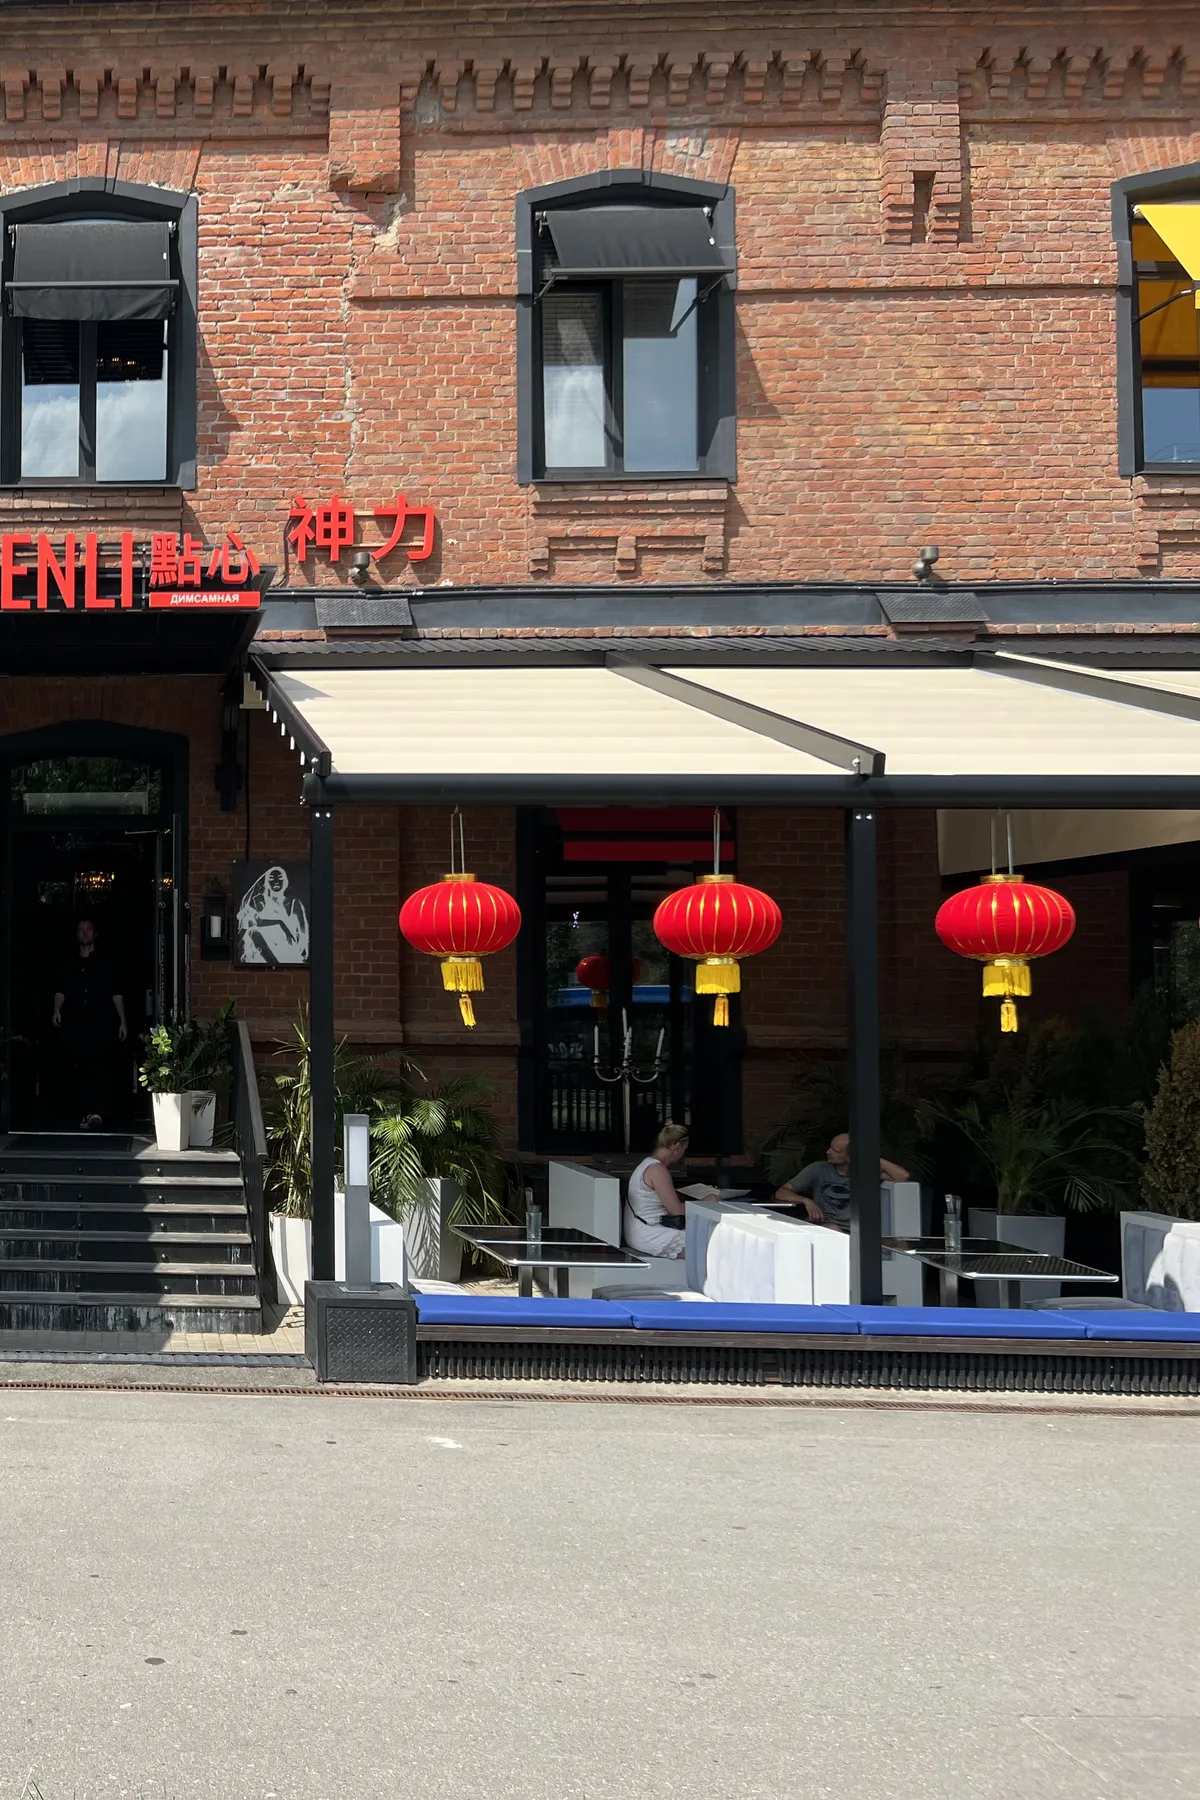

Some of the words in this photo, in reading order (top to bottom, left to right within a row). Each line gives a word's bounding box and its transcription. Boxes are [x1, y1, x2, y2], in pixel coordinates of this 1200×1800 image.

[287, 494, 436, 563] 神力
[149, 532, 260, 587] 點心
[171, 595, 240, 607] ДИМСАМНАЯ
